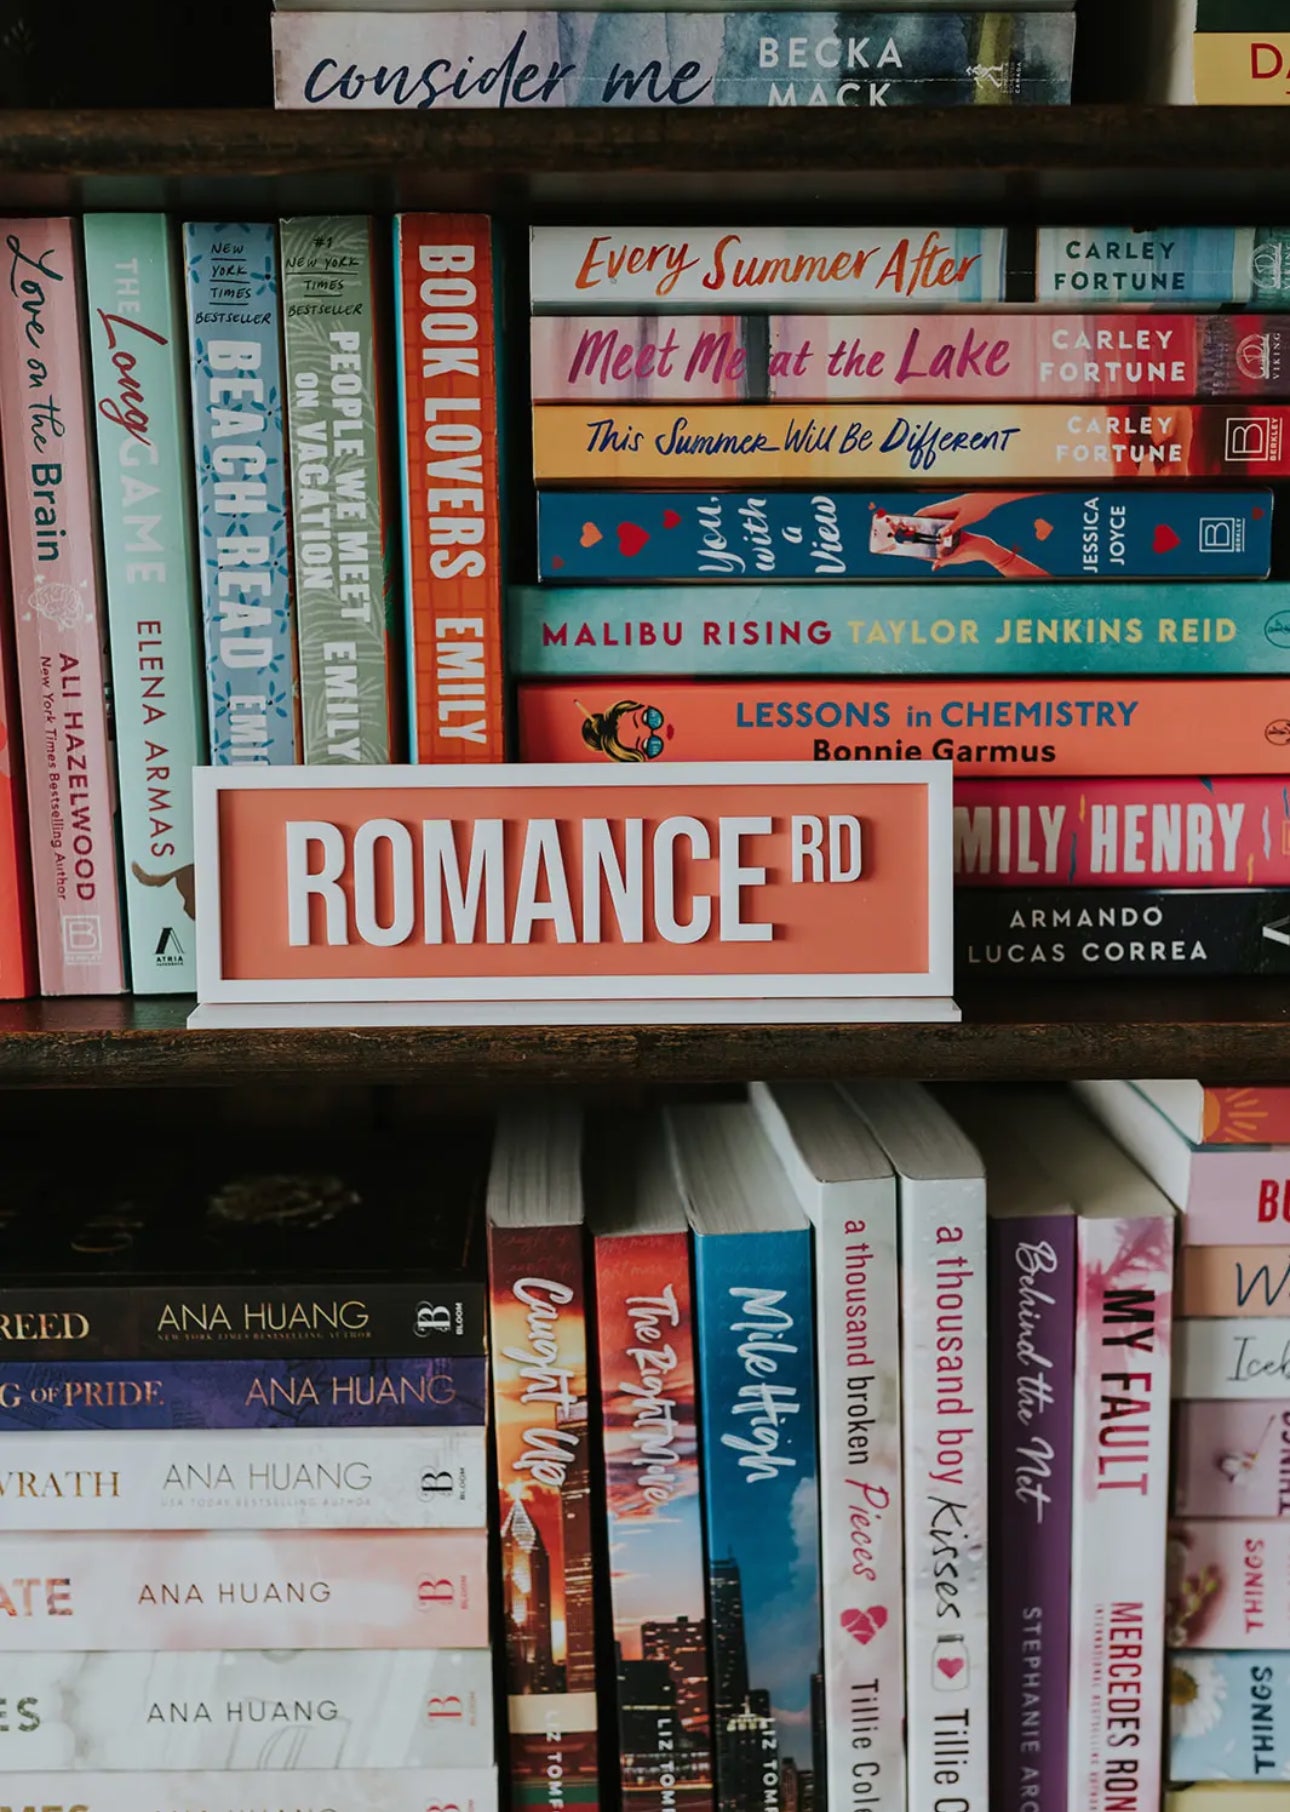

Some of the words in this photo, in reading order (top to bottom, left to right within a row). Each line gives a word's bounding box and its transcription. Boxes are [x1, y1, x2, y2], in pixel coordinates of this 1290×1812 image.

[304, 30, 576, 108] consider
[602, 59, 712, 105] me
[759, 37, 903, 68] BECKA
[768, 82, 891, 106] MACK
[211, 243, 244, 254] NEW
[211, 265, 248, 276] YORK
[286, 257, 318, 267] NEW
[324, 256, 360, 267] YORK
[313, 237, 333, 248] #1
[575, 236, 700, 296] Every
[702, 234, 880, 290] Summer
[875, 231, 982, 296] After
[1066, 241, 1175, 260] CARLEY
[6, 234, 64, 349] Love
[114, 258, 140, 313] THE
[210, 287, 252, 298] TIMES
[304, 279, 344, 291] TIMES
[1054, 272, 1186, 290] FORTUNE
[195, 312, 272, 325] BESTSELLER
[288, 304, 363, 317] BESTSELLER
[419, 245, 479, 378] BOOK
[1052, 329, 1173, 350] CARLEY
[27, 358, 48, 388] on
[97, 308, 168, 446] Long
[568, 328, 679, 384] Meet
[684, 331, 747, 384] Me
[768, 340, 814, 377] at
[827, 338, 885, 377] the
[895, 328, 1010, 384] Lake
[1040, 361, 1186, 382] FORTUNE
[1272, 333, 1280, 379] VIKING
[295, 372, 319, 408] ON
[329, 331, 364, 458] PEOPLE
[30, 395, 65, 453] the
[207, 340, 268, 514] BEACH
[587, 418, 645, 452] This
[784, 418, 838, 453] Will
[838, 421, 873, 454] Be
[1068, 416, 1173, 434] CARLEY
[1270, 417, 1278, 462] BERKLEY
[1056, 444, 1183, 463] FORTUNE
[31, 463, 67, 561] Brain
[118, 438, 166, 584] GAME
[297, 420, 333, 589] VACATION
[336, 469, 366, 520] WE
[424, 398, 487, 580] LOVERS
[696, 496, 746, 574] You,
[738, 498, 776, 571] with
[782, 526, 803, 544] a
[810, 495, 847, 574] View
[1083, 496, 1099, 574] JESSICA
[1109, 505, 1126, 566] JOYCE
[216, 536, 273, 669] READ
[337, 531, 372, 623] MEET
[542, 621, 683, 646] MALIBU
[703, 620, 832, 646] RISING
[847, 618, 980, 645] TAYLOR
[995, 617, 1144, 644] JENKINS
[1158, 618, 1237, 643] REID
[40, 656, 53, 687] New
[59, 652, 82, 698] ALI
[137, 619, 166, 725] ELENA
[435, 618, 487, 744] EMILY
[42, 692, 56, 723] York
[323, 641, 361, 762] EMILY
[737, 701, 891, 728] LESSONS
[906, 705, 932, 728] in
[941, 700, 1140, 728] CHEMISTRY
[45, 728, 58, 769] Times
[813, 737, 922, 761] Bonnie
[932, 737, 1056, 762] Garmus
[50, 773, 65, 849] Bestselling
[64, 711, 96, 902] HAZELWOOD
[144, 739, 175, 858] ARMAS
[1090, 803, 1245, 873] HENRY
[55, 852, 68, 900] Author
[286, 815, 774, 947] ROMANCE
[791, 814, 862, 883] RD
[1009, 906, 1164, 928] ARMANDO
[968, 943, 1066, 963] LUCAS
[1082, 941, 1208, 962] CORREA
[844, 1219, 867, 1235] a
[936, 1226, 964, 1245] a
[157, 1303, 232, 1331] ANA
[244, 1301, 370, 1331] HUANG
[456, 1302, 464, 1335] BLOOM
[625, 1284, 680, 1344] The
[728, 1287, 799, 1378] Mile
[845, 1242, 876, 1367] thousand
[1015, 1240, 1058, 1368] Behind
[1101, 1290, 1156, 1353] MY
[501, 1277, 578, 1419] Caught
[936, 1255, 975, 1416] thousand
[31, 1387, 60, 1403] OF
[64, 1381, 164, 1407] PRIDE
[245, 1377, 320, 1407] ANA
[333, 1375, 457, 1405] HUANG
[618, 1344, 679, 1428] Right
[1016, 1371, 1056, 1427] the
[720, 1381, 800, 1483] High
[846, 1375, 876, 1466] broken
[1097, 1373, 1152, 1496] FAULT
[162, 1463, 235, 1490] ANA
[250, 1462, 373, 1490] HUANG
[512, 1427, 580, 1487] Up
[630, 1428, 680, 1503] Move
[929, 1427, 975, 1485] boy
[1015, 1436, 1056, 1525] Net
[845, 1478, 890, 1582] Pieces
[927, 1495, 969, 1619] Kisses
[137, 1583, 204, 1605] ANA
[218, 1581, 331, 1604] HUANG
[460, 1575, 468, 1610] BLOOM
[1244, 1538, 1265, 1634] THINGS
[1020, 1606, 1043, 1753] STEPHANIE
[1106, 1602, 1144, 1748] MERCEDES
[147, 1702, 212, 1723] ANA
[226, 1700, 338, 1722] HUANG
[544, 1711, 562, 1743] LIZ
[657, 1718, 673, 1750] LIZ
[760, 1717, 777, 1750] LIZ
[851, 1678, 880, 1750] Tillie
[1250, 1665, 1277, 1775] THINGS
[934, 1707, 970, 1785] Tillie
[546, 1752, 564, 1812] TOMF
[1104, 1759, 1139, 1812] RON
